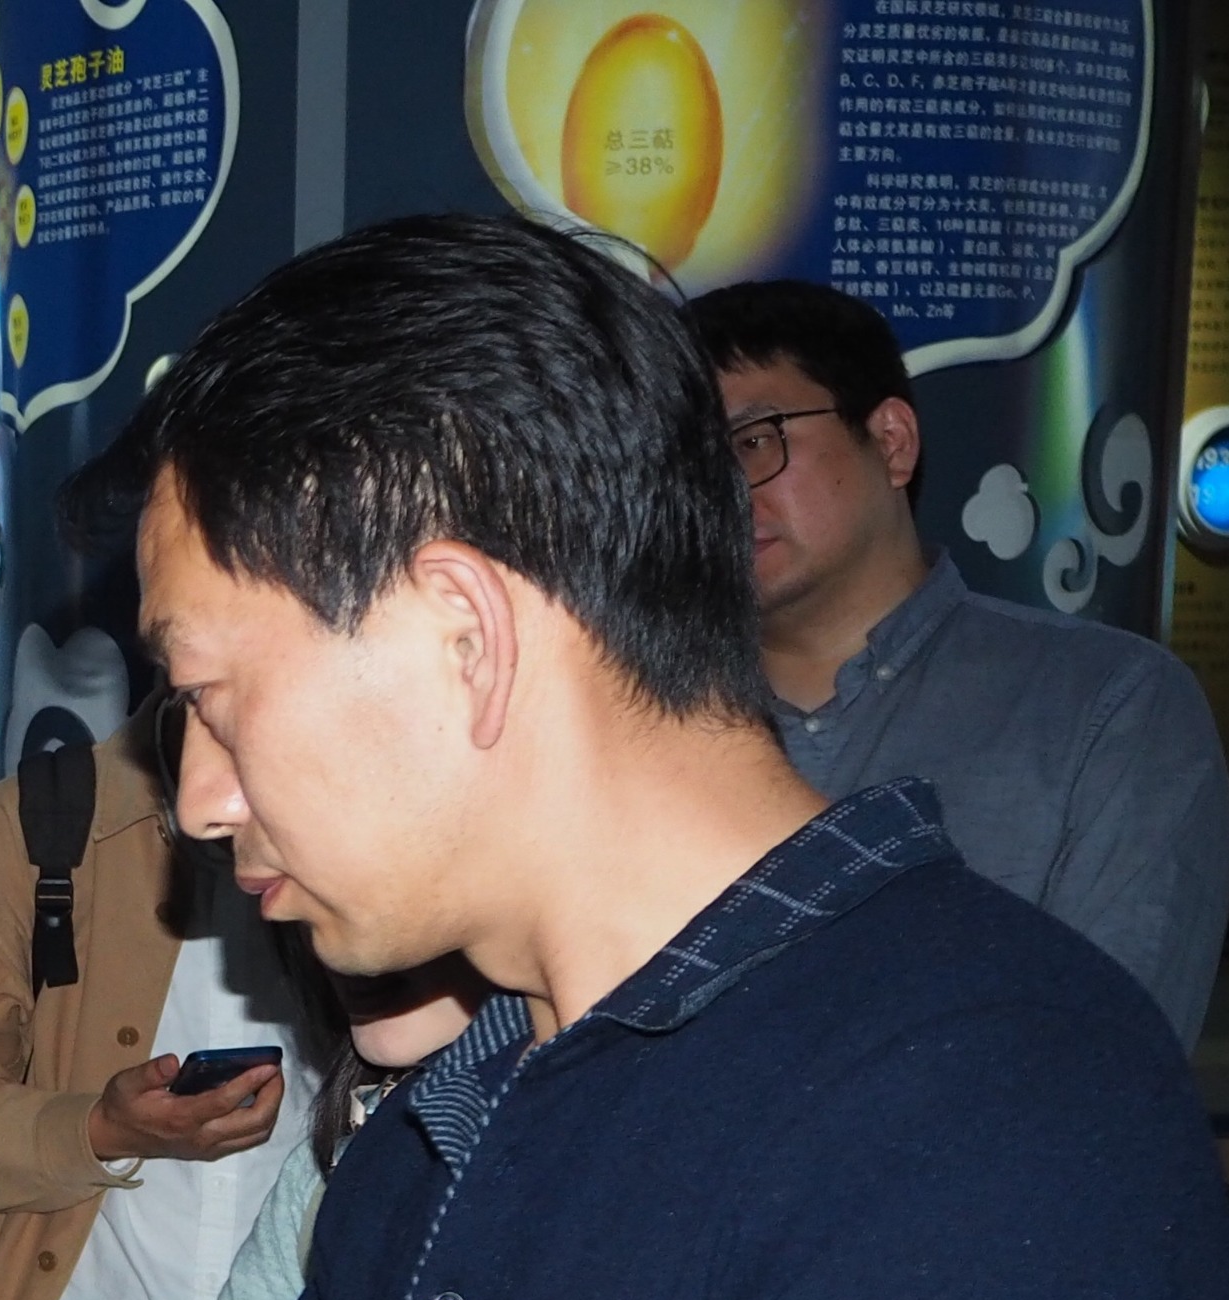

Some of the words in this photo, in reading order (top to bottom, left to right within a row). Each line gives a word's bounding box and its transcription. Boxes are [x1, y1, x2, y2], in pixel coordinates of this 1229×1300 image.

[40, 45, 125, 92] 灵芝孢子油
